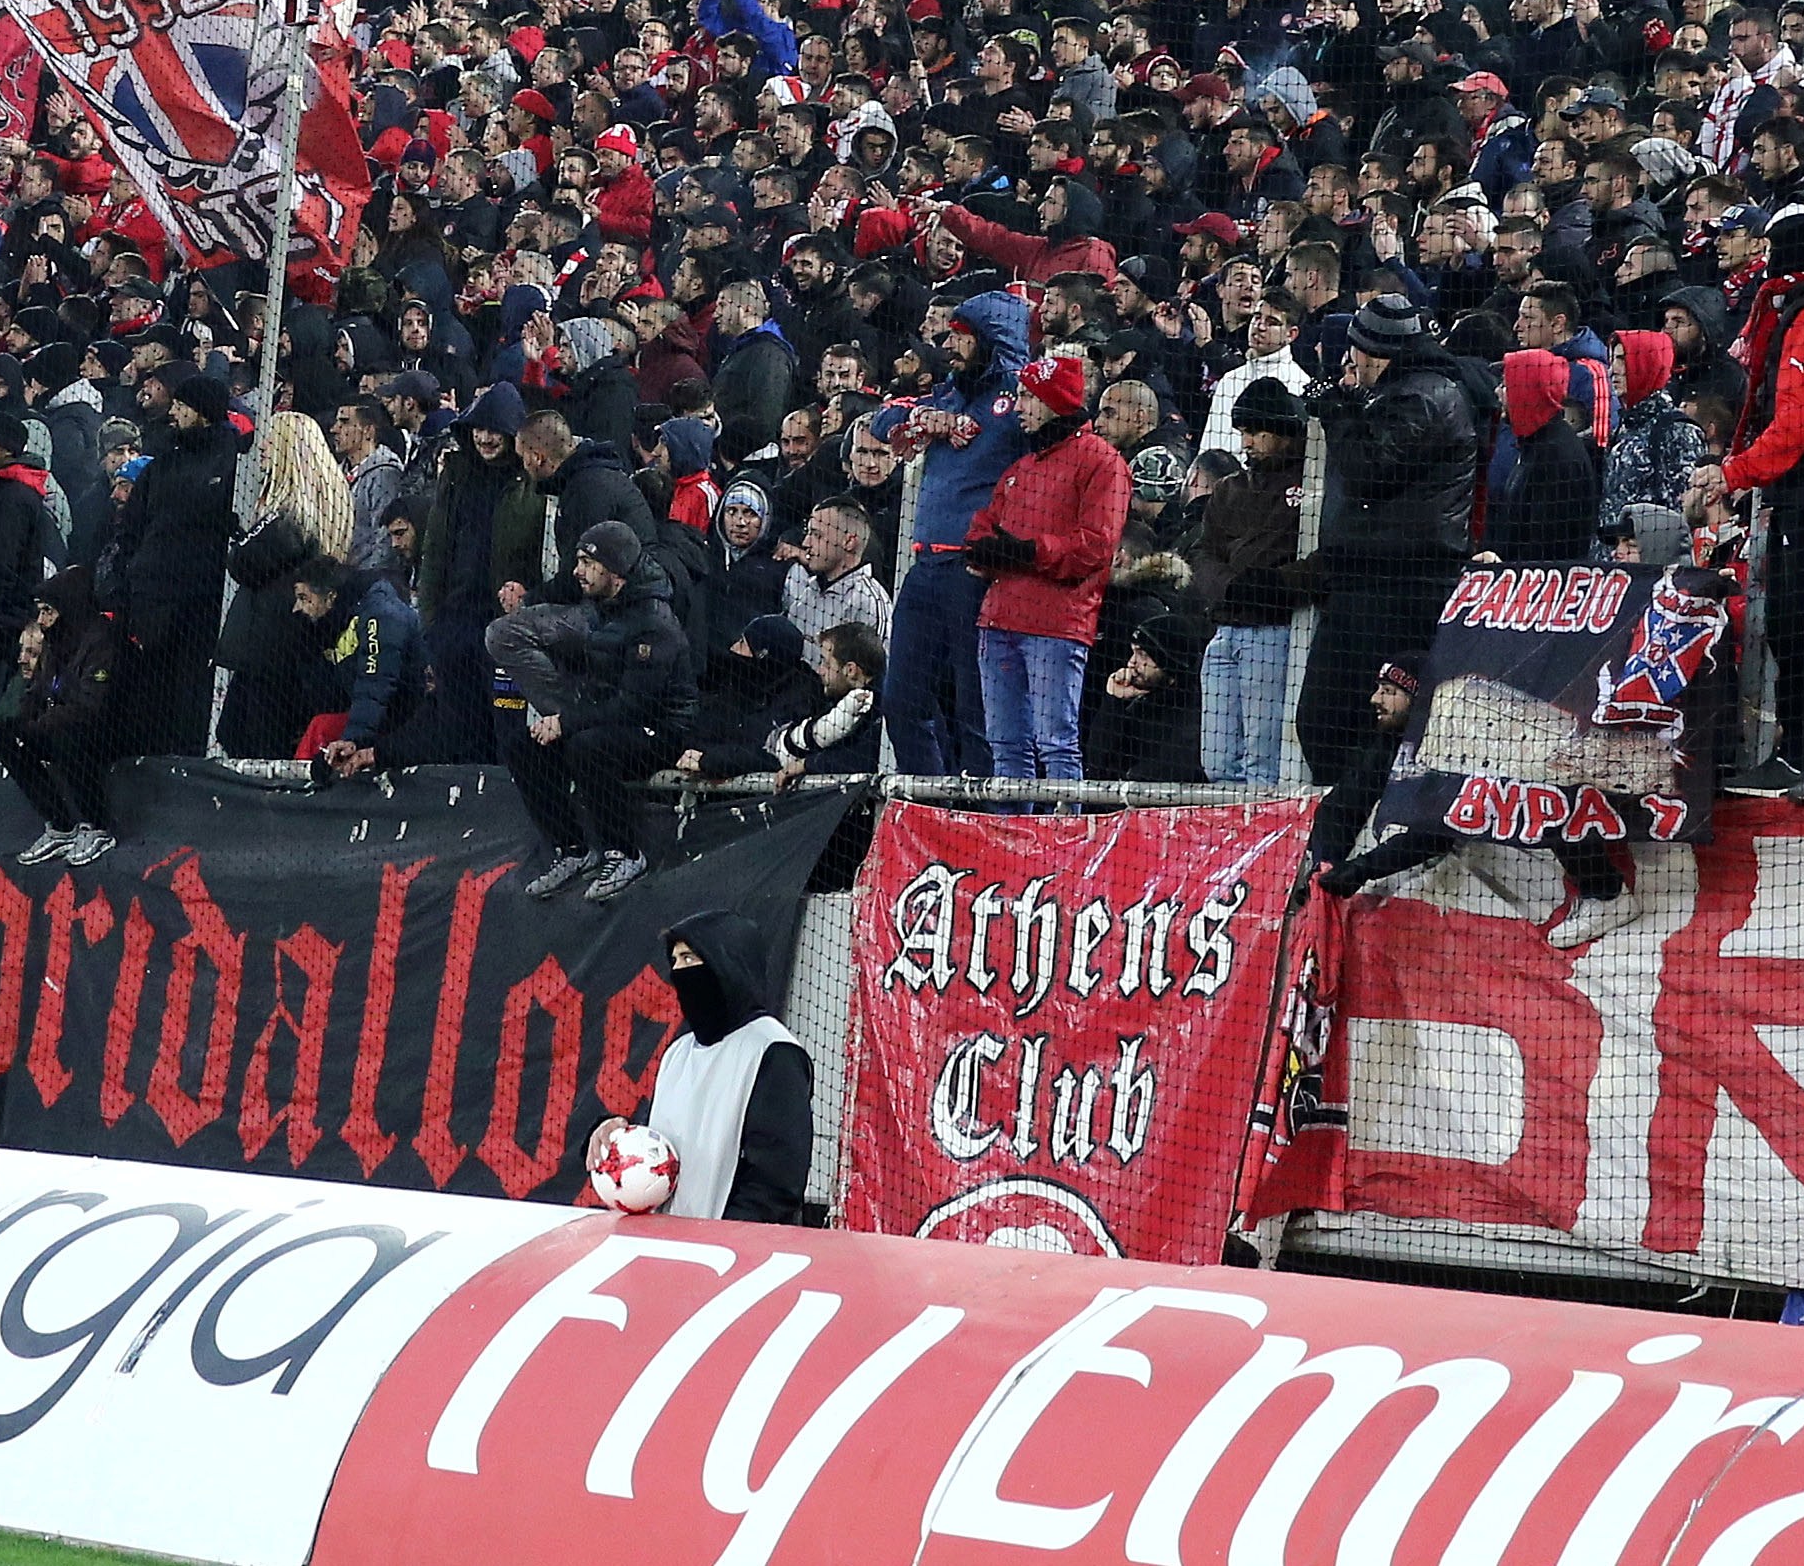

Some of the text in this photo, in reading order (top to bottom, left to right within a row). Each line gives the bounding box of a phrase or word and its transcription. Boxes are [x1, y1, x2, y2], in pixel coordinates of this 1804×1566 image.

[1438, 565, 1633, 635] ΡΑΚΛΕΙΟ
[1638, 792, 1689, 842] 7
[880, 859, 1249, 1019] Athens
[929, 1032, 1157, 1166] Club
[425, 1232, 966, 1566] Fly
